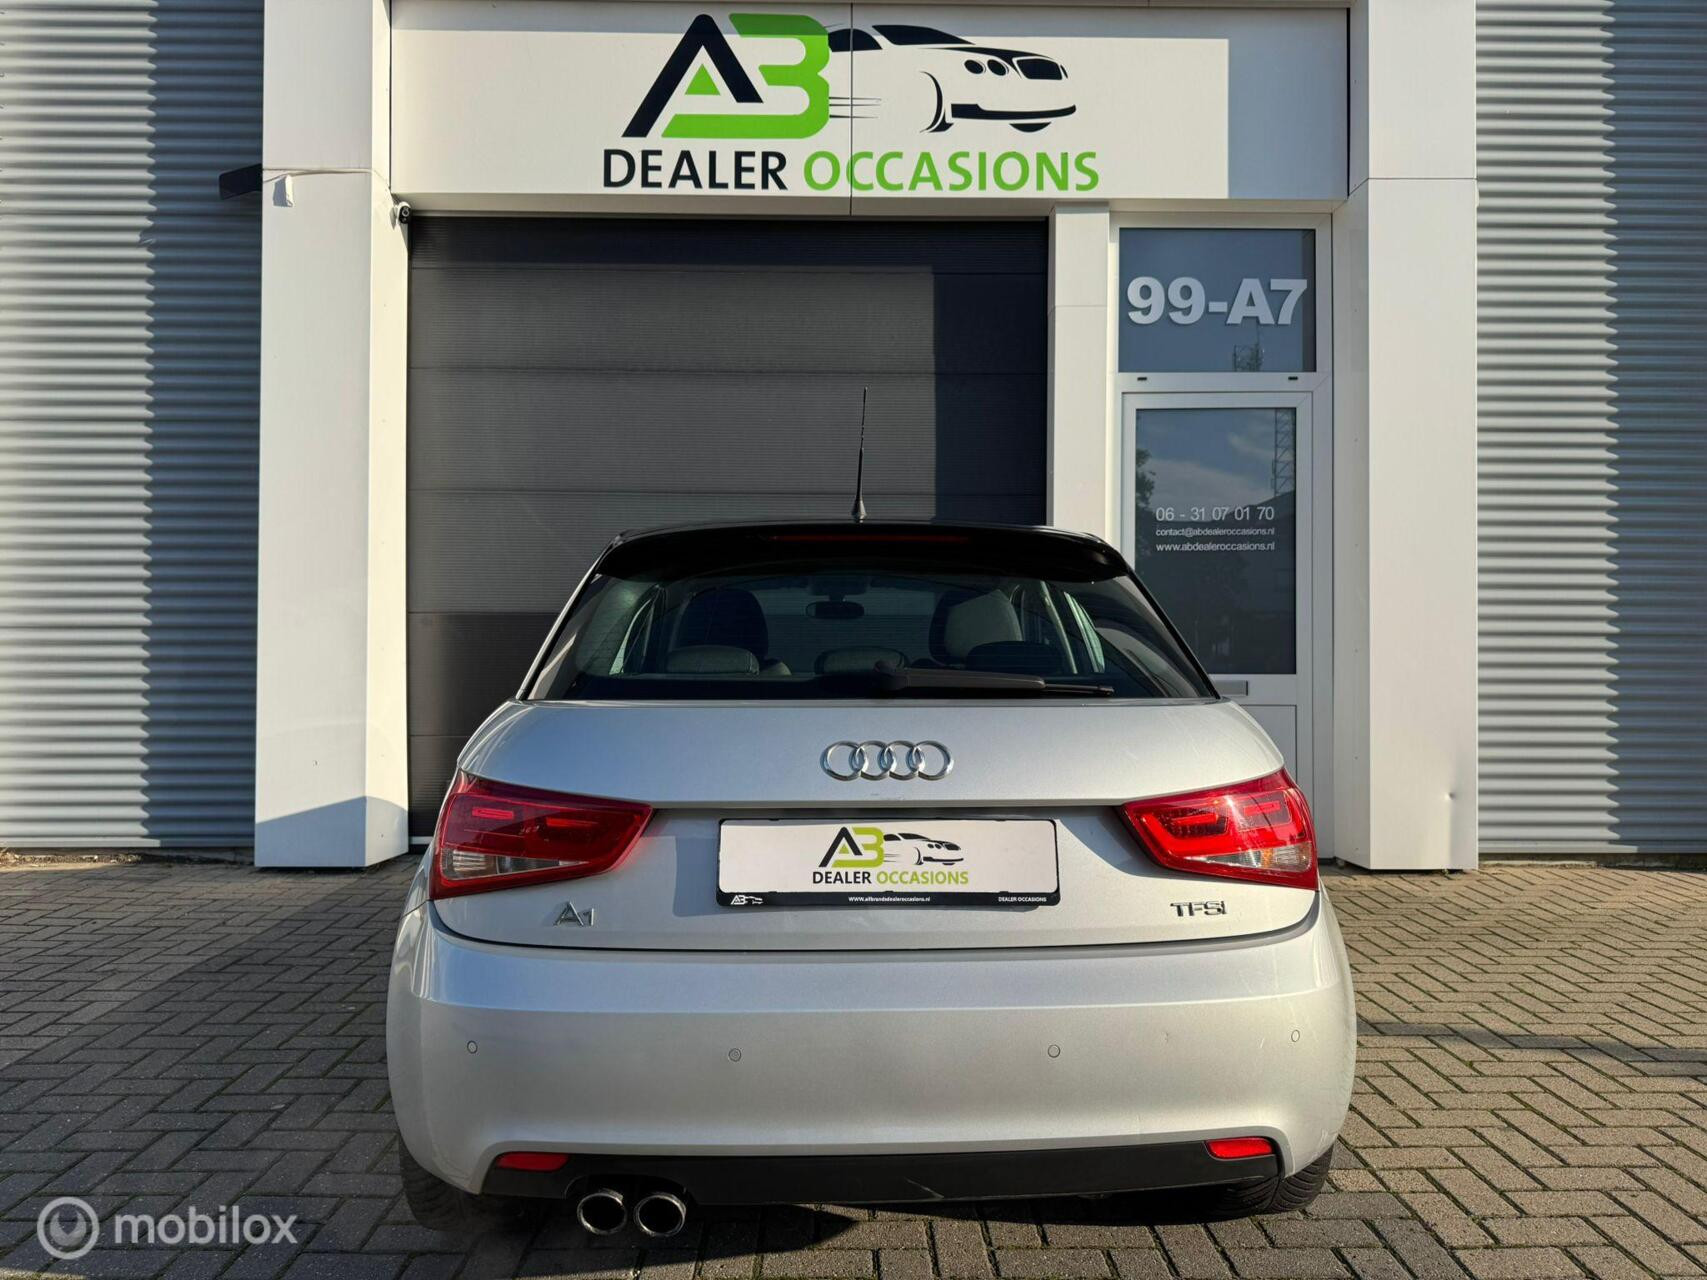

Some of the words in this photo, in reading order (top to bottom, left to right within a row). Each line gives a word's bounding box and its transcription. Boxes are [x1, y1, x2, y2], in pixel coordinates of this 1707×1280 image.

[603, 148, 788, 191] DEALER
[803, 150, 1100, 192] OCCASIONS
[1126, 276, 1308, 325] 99-A7
[1155, 506, 1175, 521] 06
[1190, 506, 1206, 521] 31
[1212, 506, 1230, 521] 07
[1234, 506, 1250, 521] 01
[1256, 506, 1275, 521] 70
[1155, 527, 1275, 538] contact@abdealeroccasions.nl
[1155, 542, 1276, 551] www.abdealeroccasions.nl
[812, 870, 872, 884] DEALER
[876, 870, 969, 885] OCCASIONS
[552, 901, 595, 927] A1
